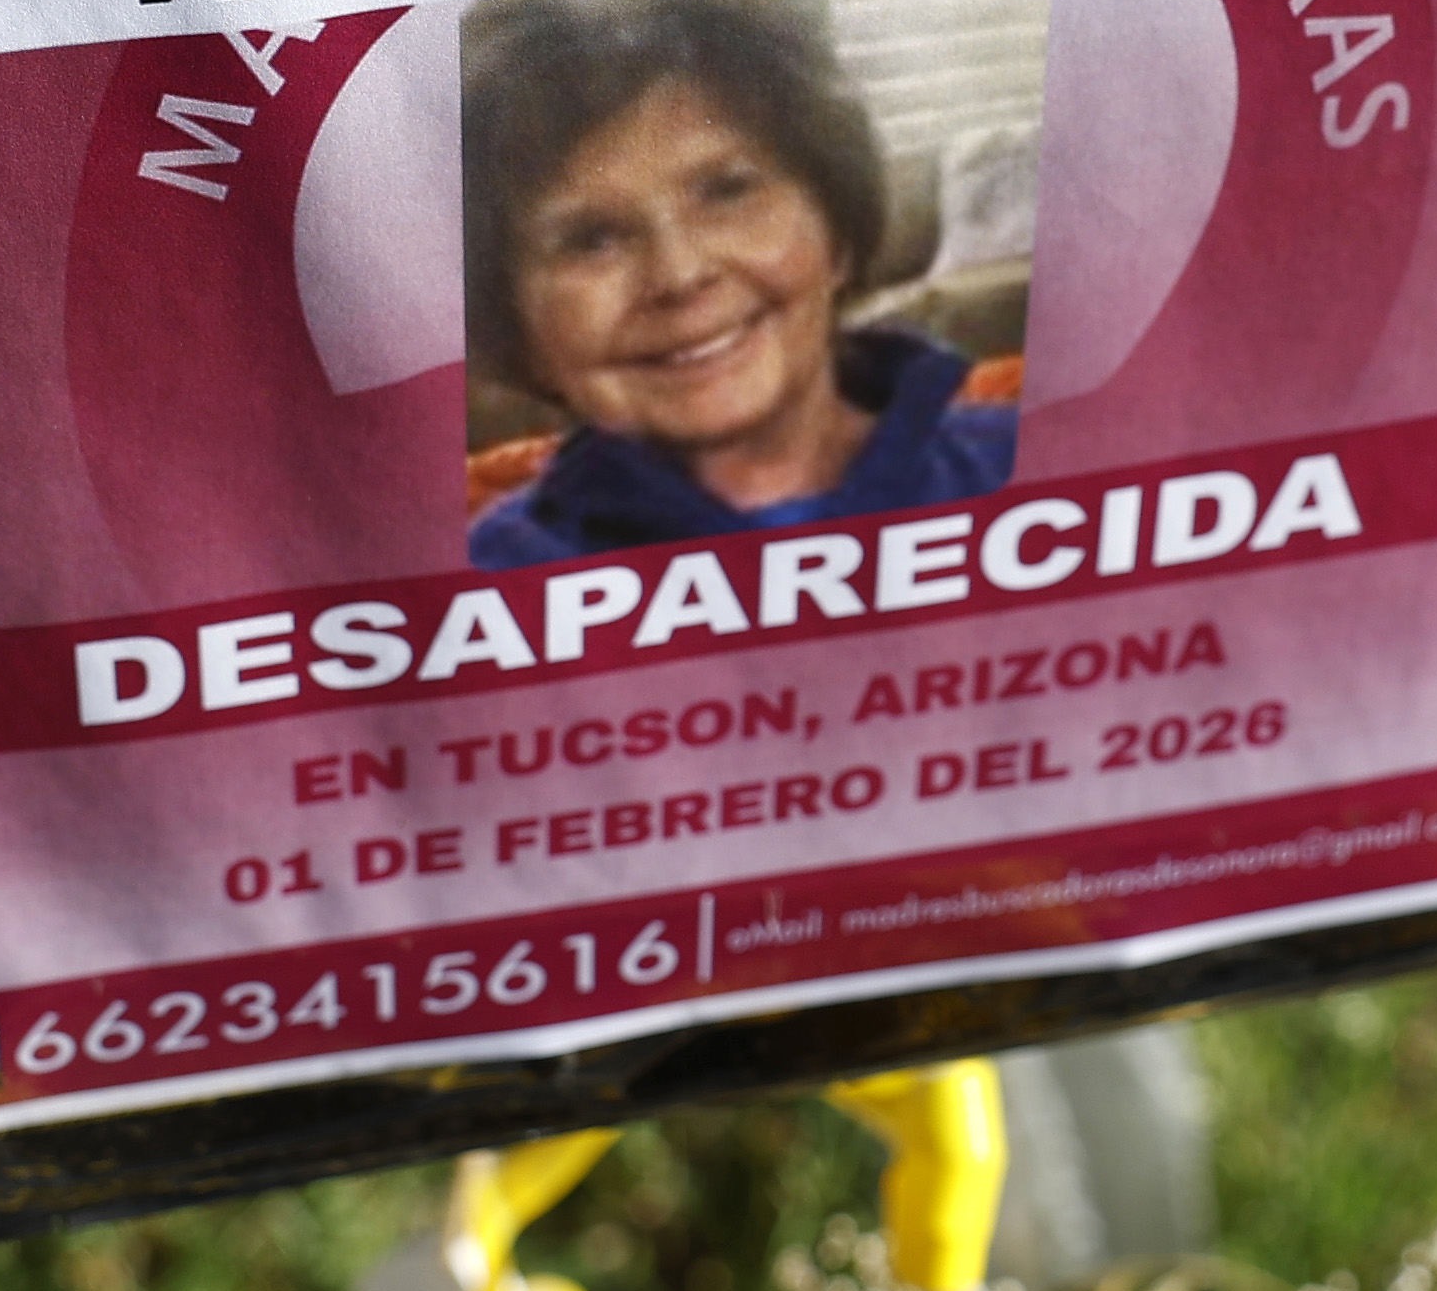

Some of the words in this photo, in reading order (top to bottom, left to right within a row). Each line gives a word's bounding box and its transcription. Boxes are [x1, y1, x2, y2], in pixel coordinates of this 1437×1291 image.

[75, 452, 1363, 727] DESAPARECIDA
[224, 850, 323, 905] 01
[354, 828, 466, 885] DE
[495, 765, 885, 865] FEBRERO
[916, 740, 1071, 800] DEL
[1098, 700, 1288, 772] 2026
[293, 747, 408, 806] EN
[439, 687, 824, 785] TUCSON,
[853, 621, 1227, 725] ARIZONA
[14, 920, 680, 1076] 6623415616
